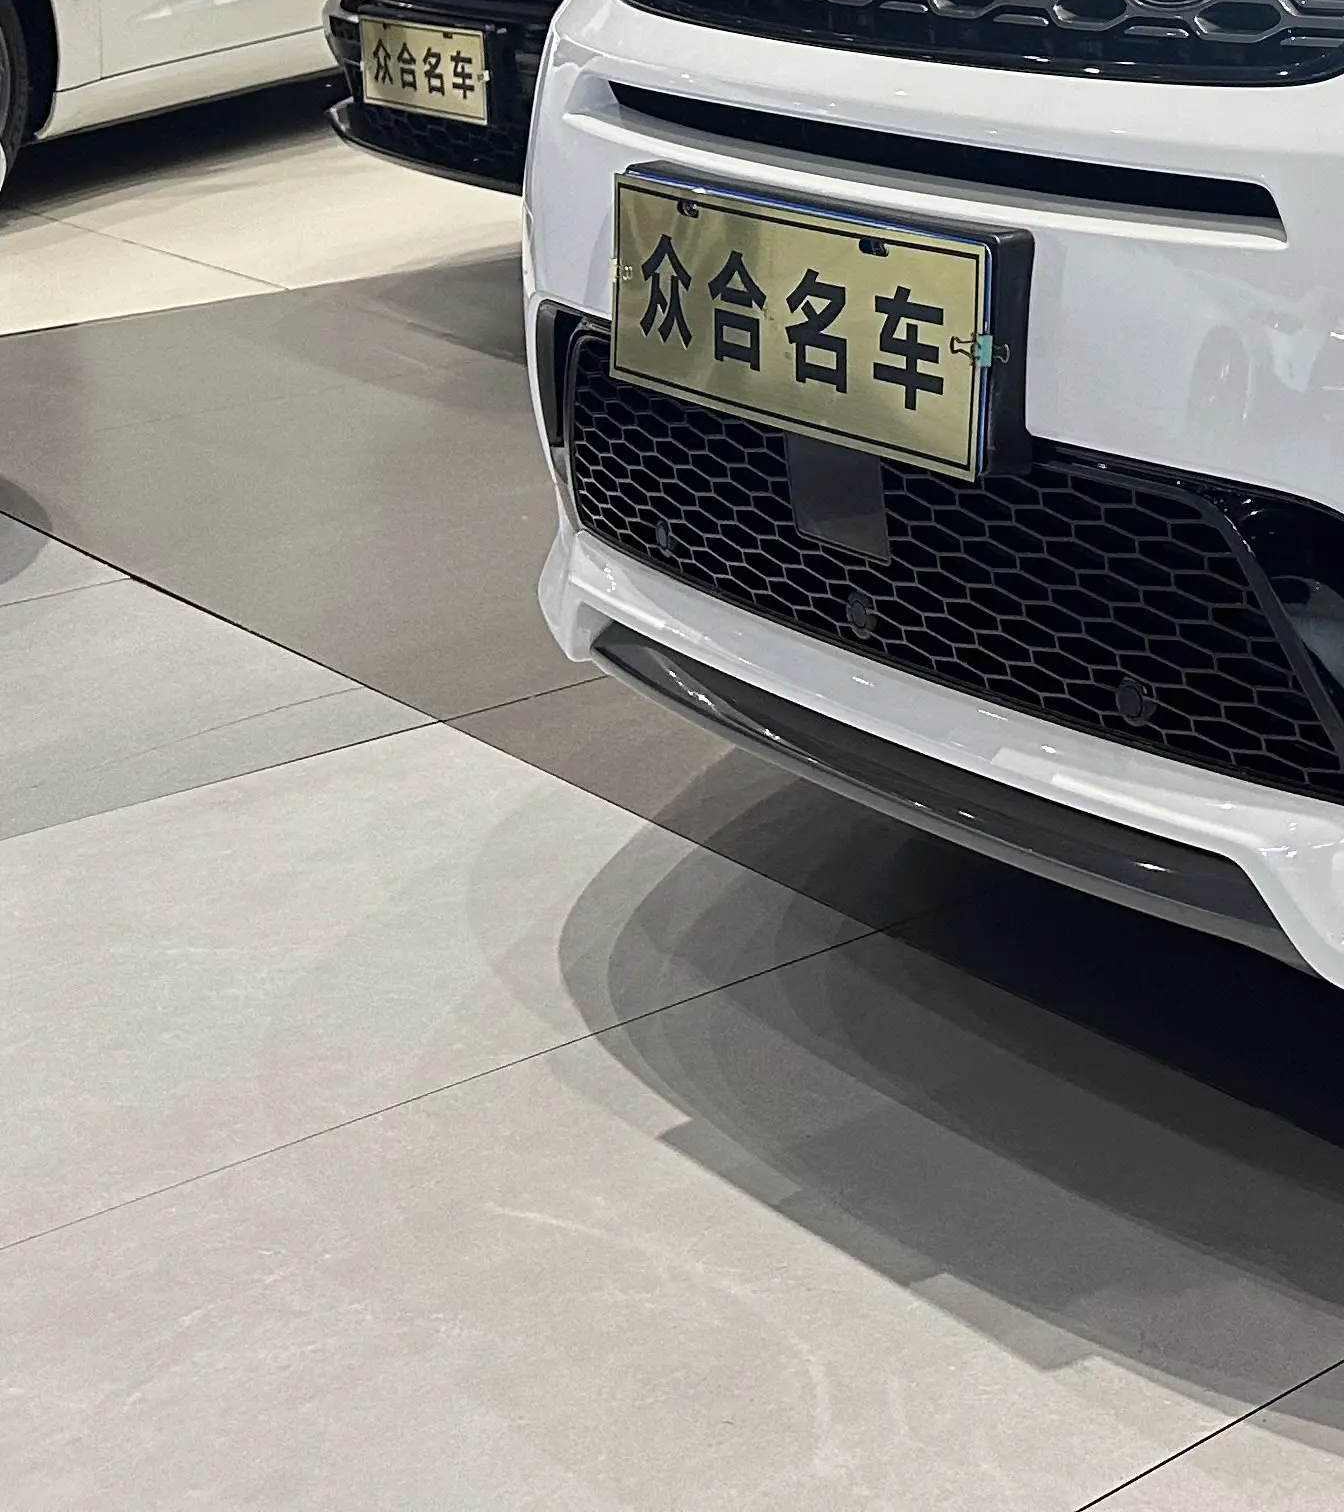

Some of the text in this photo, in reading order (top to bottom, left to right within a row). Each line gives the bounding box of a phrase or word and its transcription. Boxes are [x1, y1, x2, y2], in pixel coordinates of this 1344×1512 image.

[372, 38, 476, 100] 众合名车
[639, 233, 945, 411] 众合名车
